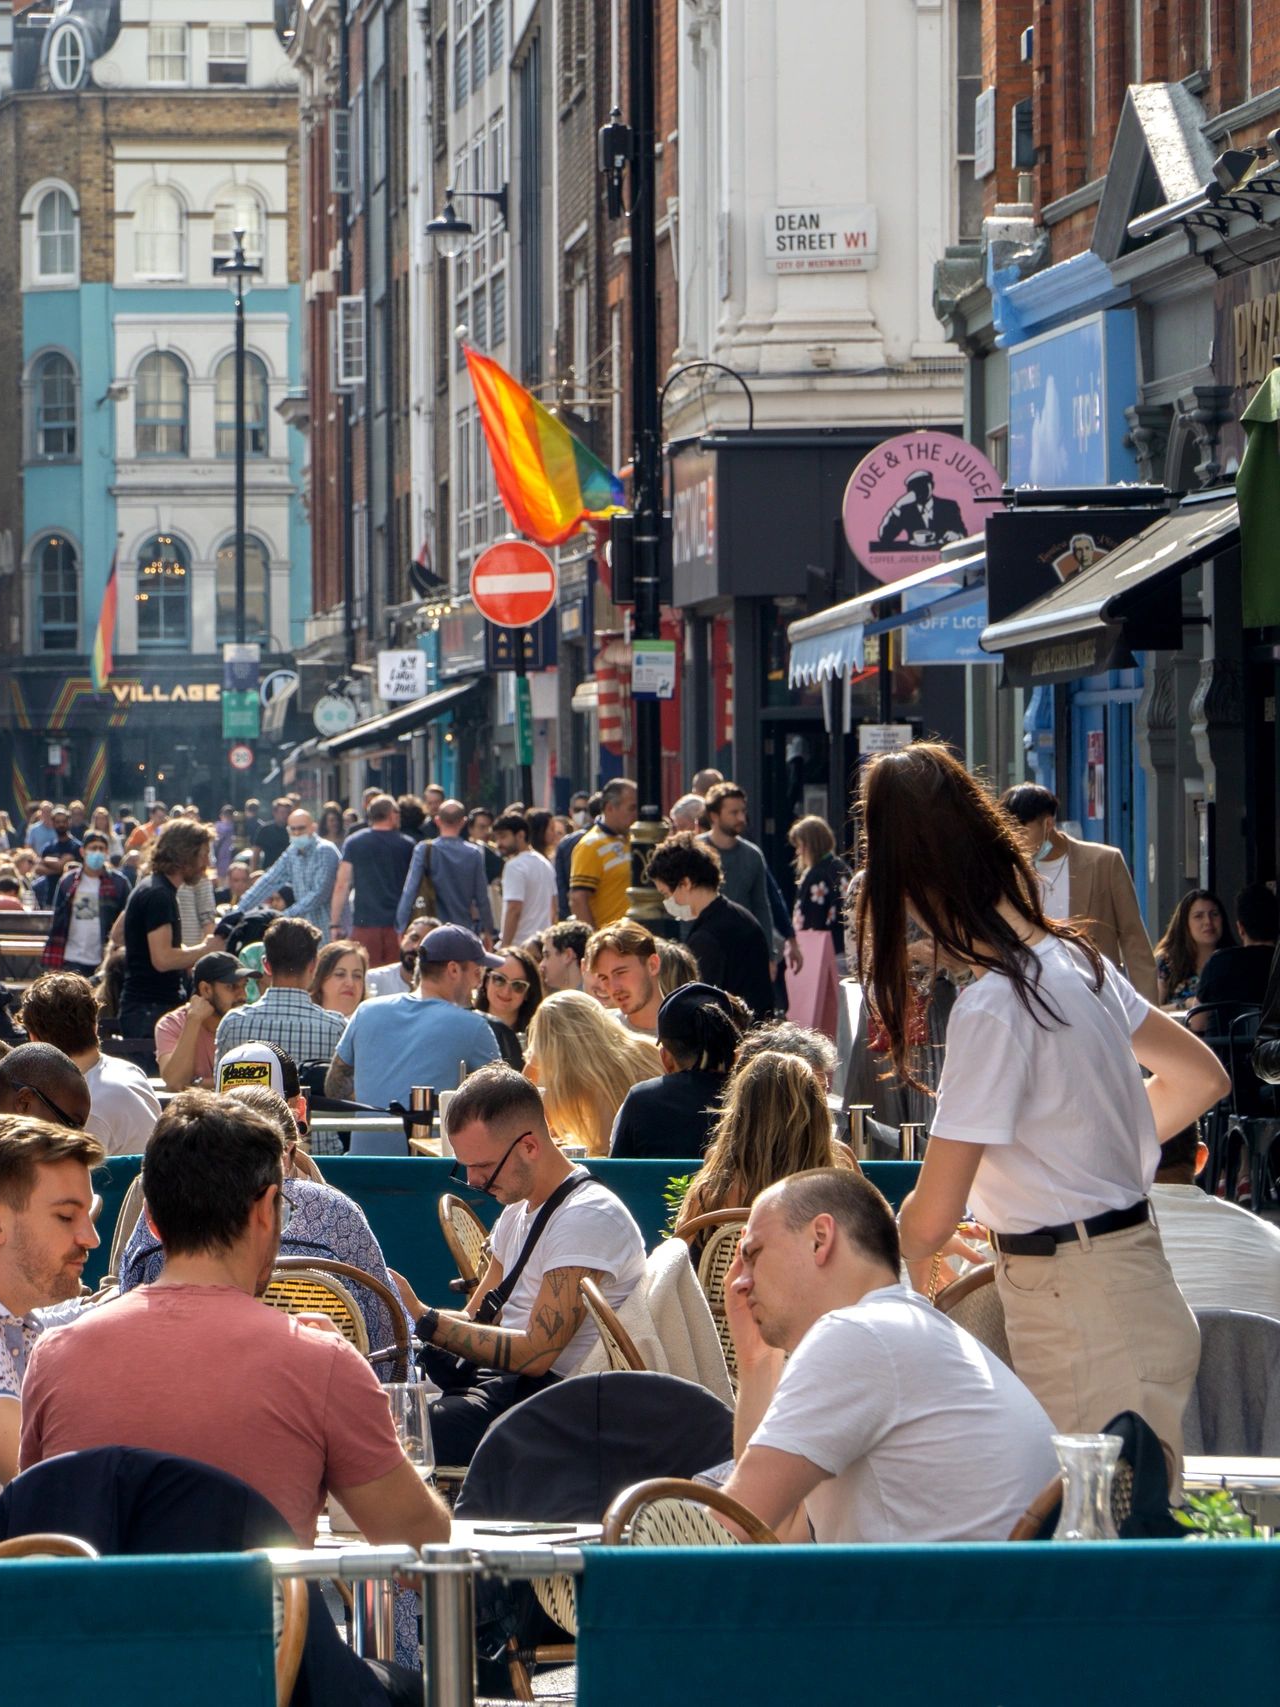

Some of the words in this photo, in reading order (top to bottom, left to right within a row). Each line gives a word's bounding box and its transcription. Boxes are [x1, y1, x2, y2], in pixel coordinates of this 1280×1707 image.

[775, 213, 820, 231] DEAN
[776, 232, 837, 252] STREET
[844, 230, 867, 249] W1
[776, 261, 794, 270] CITY
[795, 260, 805, 268] OF
[807, 258, 862, 268] WESTMINSTER
[855, 461, 886, 500] JOE
[883, 450, 900, 469] &
[903, 442, 943, 462] THE
[944, 451, 993, 496] JUICE
[900, 554, 919, 563] JUICE
[921, 554, 938, 563] AND
[919, 615, 949, 631] OFF
[952, 614, 987, 630] LICE
[111, 684, 221, 702] VILLAGE
